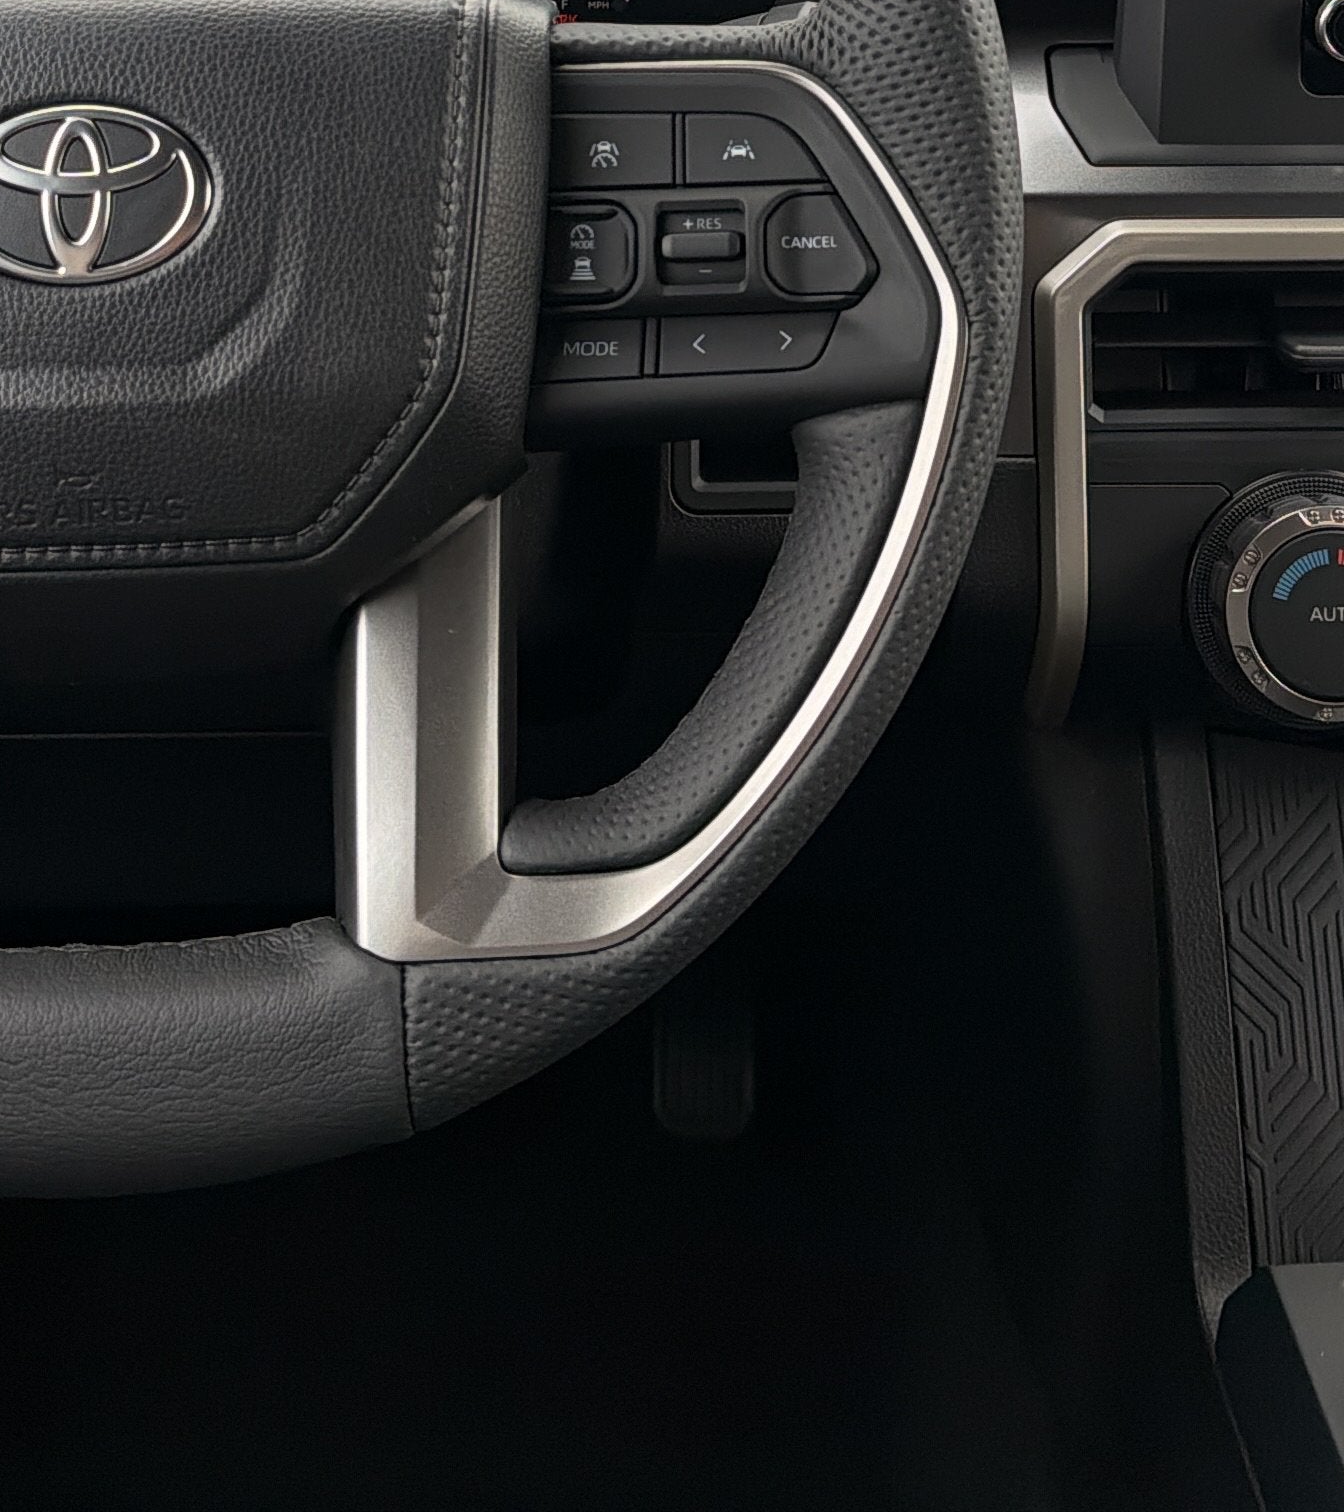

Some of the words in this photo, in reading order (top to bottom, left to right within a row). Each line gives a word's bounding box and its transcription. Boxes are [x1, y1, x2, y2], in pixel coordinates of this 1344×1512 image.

[587, 1, 610, 9] MPH
[569, 240, 596, 250] MODE
[781, 235, 838, 250] CANCEL
[562, 341, 619, 357] MODE
[46, 497, 190, 528] AIRBAG
